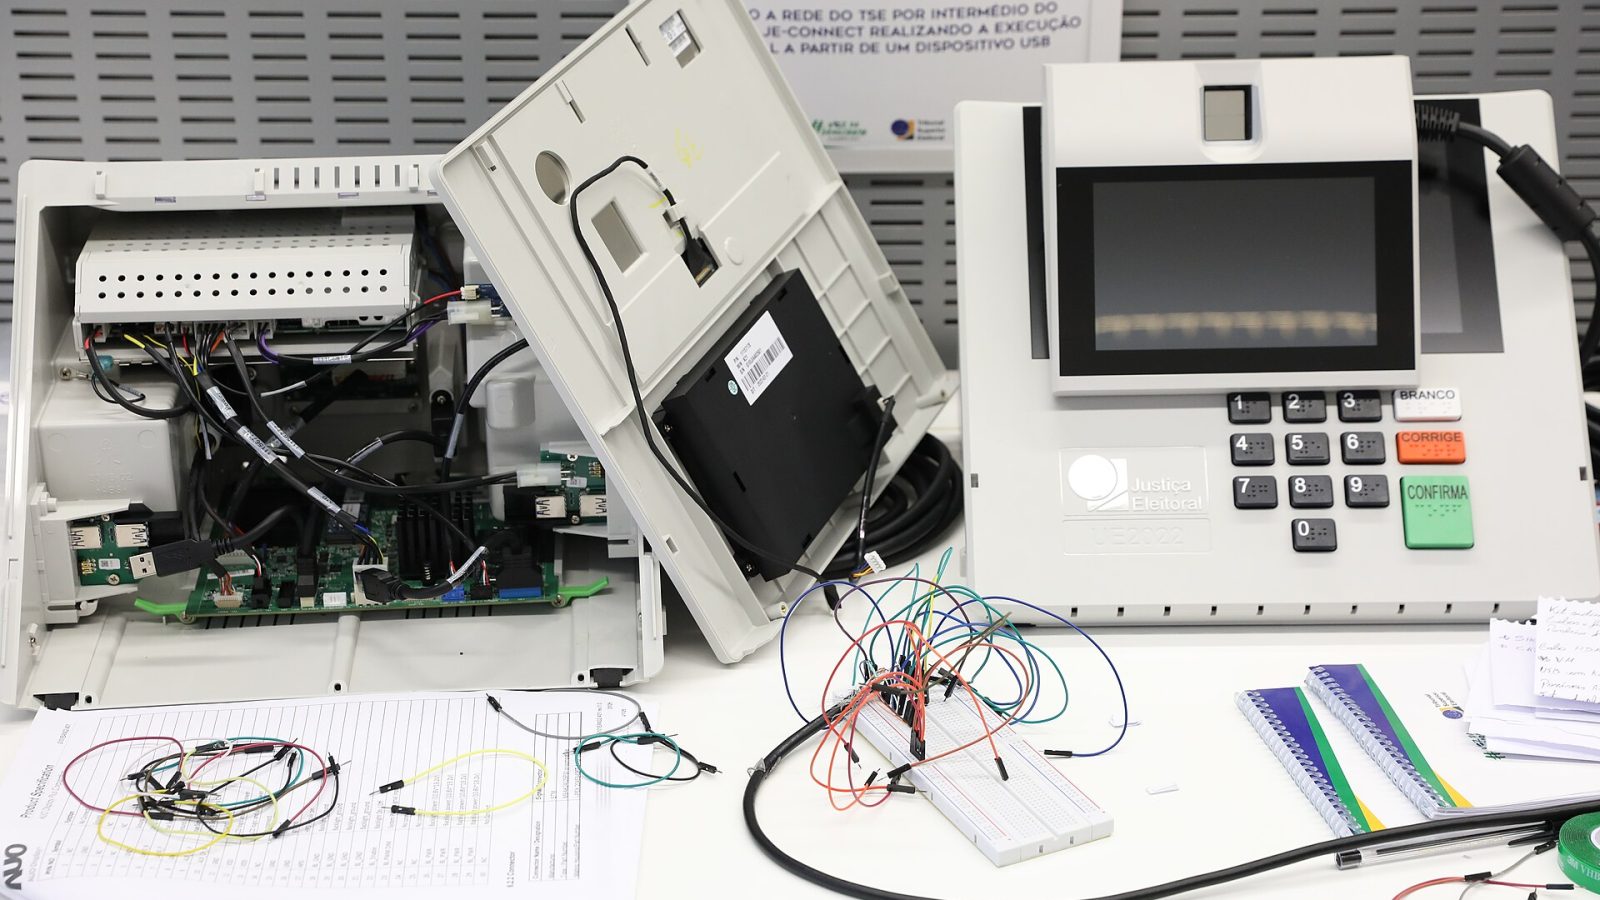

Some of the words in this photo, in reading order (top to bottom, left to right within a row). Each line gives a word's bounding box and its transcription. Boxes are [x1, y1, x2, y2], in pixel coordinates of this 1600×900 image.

[766, 10, 777, 20] A
[782, 9, 823, 21] REDE
[829, 9, 853, 21] DO
[859, 9, 886, 21] TSE
[893, 8, 926, 20] POR
[931, 3, 1029, 19] INTERMÉDIO
[1034, 1, 1058, 15] DO
[870, 24, 973, 37] REALIZANDO
[978, 24, 989, 34] A
[994, 15, 1082, 34] EXECUÇÃO
[784, 44, 795, 54] A
[800, 43, 854, 54] PARTIR
[859, 43, 880, 54] DE
[886, 43, 910, 54] UM
[915, 38, 1015, 53] DISPOSITIVO
[1019, 36, 1051, 49] USB
[1288, 394, 1300, 409] 2
[1343, 393, 1356, 408] 3
[1399, 389, 1456, 400] BRANCO
[1234, 396, 1243, 410] 1
[1235, 435, 1248, 450] 4
[1291, 435, 1304, 450] 5
[1346, 434, 1359, 449] 6
[1401, 432, 1462, 443] CORRIGE
[1130, 477, 1192, 496] Justiça
[1238, 478, 1250, 493] 7
[1294, 478, 1306, 493] 8
[1350, 477, 1363, 492] 9
[1407, 484, 1469, 500] CONFIRMA
[1131, 496, 1203, 512] Eleitoral
[1297, 520, 1310, 536] 0
[20, 797, 39, 819] Product
[30, 764, 54, 798] Specification
